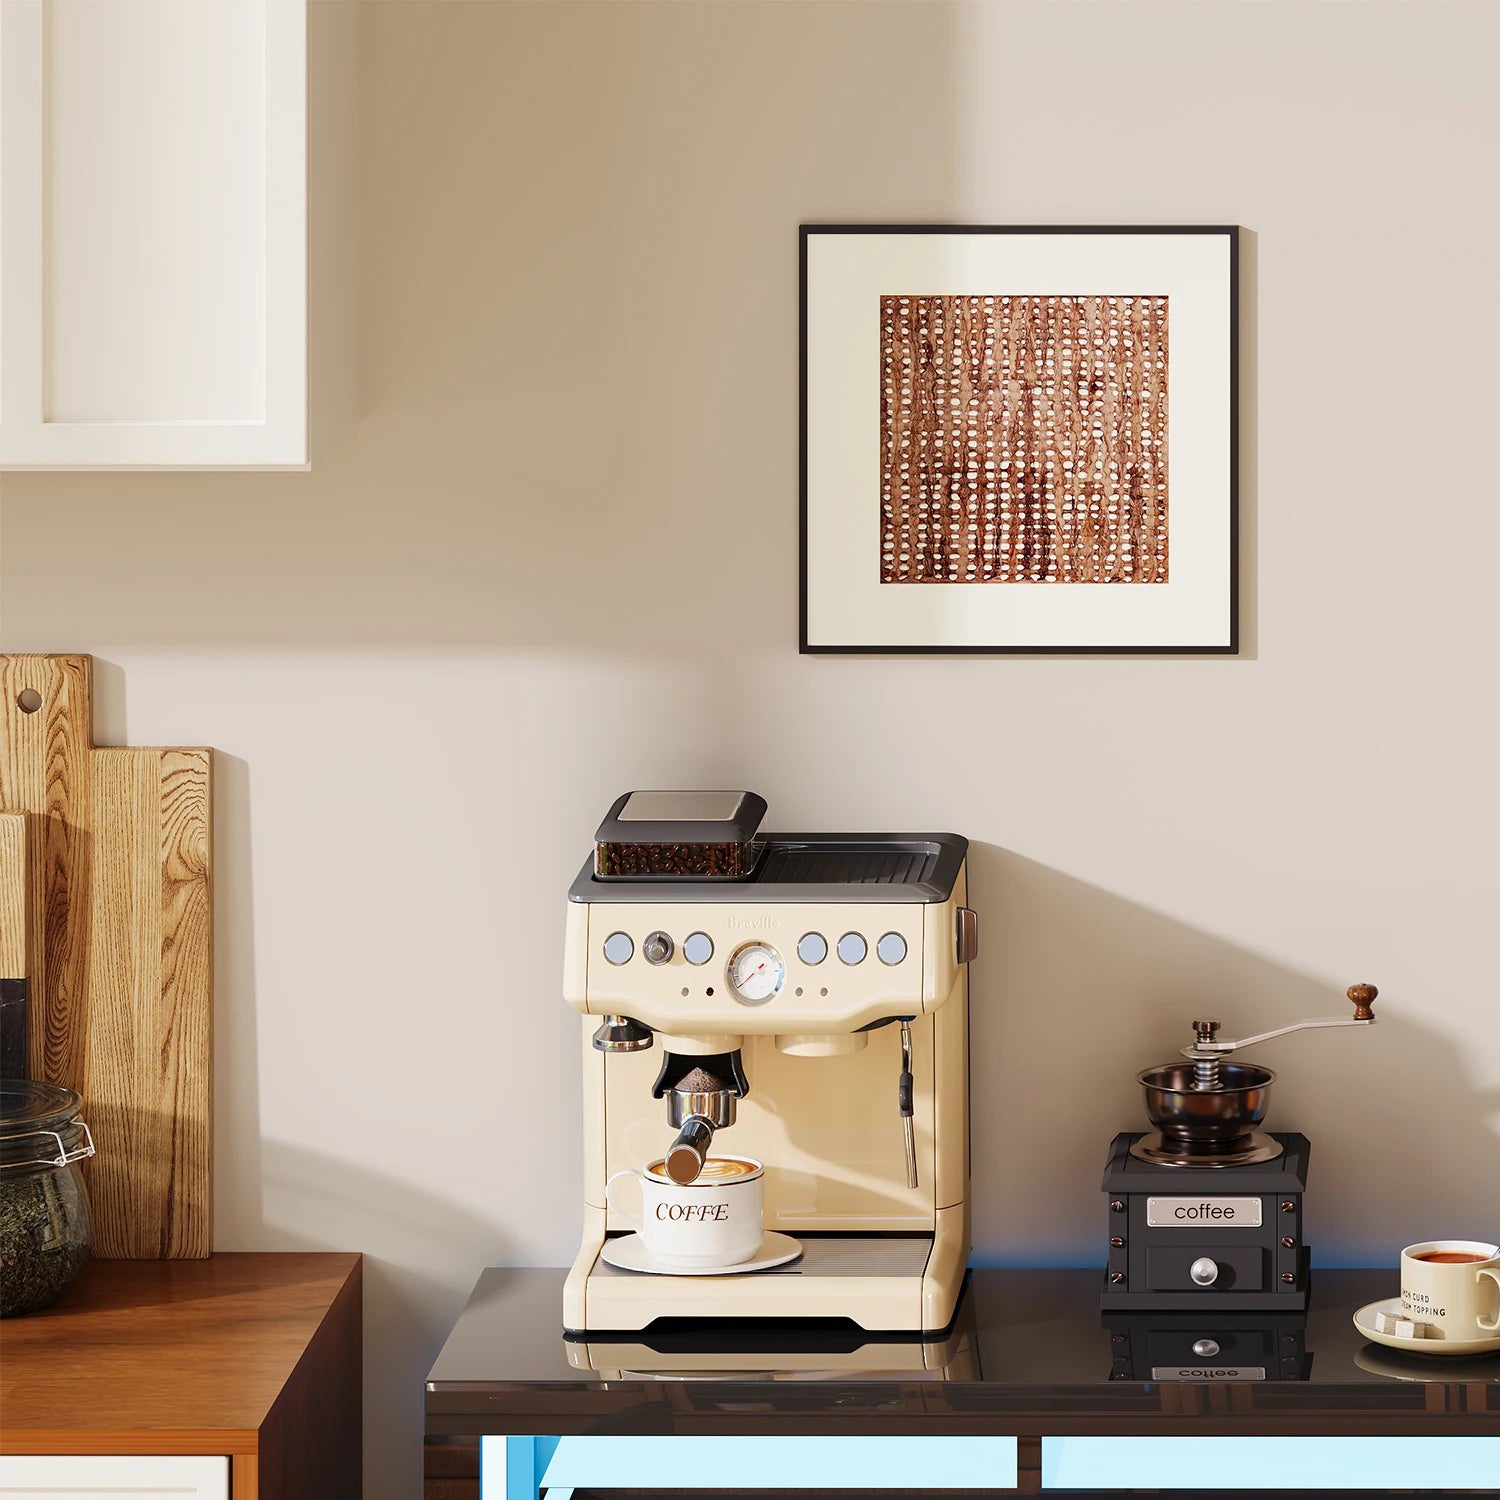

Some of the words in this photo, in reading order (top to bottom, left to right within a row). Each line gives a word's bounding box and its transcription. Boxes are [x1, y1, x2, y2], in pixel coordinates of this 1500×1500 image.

[656, 1203, 729, 1221] COFFE
[1174, 1203, 1235, 1219] coffee
[1412, 1292, 1430, 1303] CURD
[1413, 1304, 1446, 1317] TOPPING
